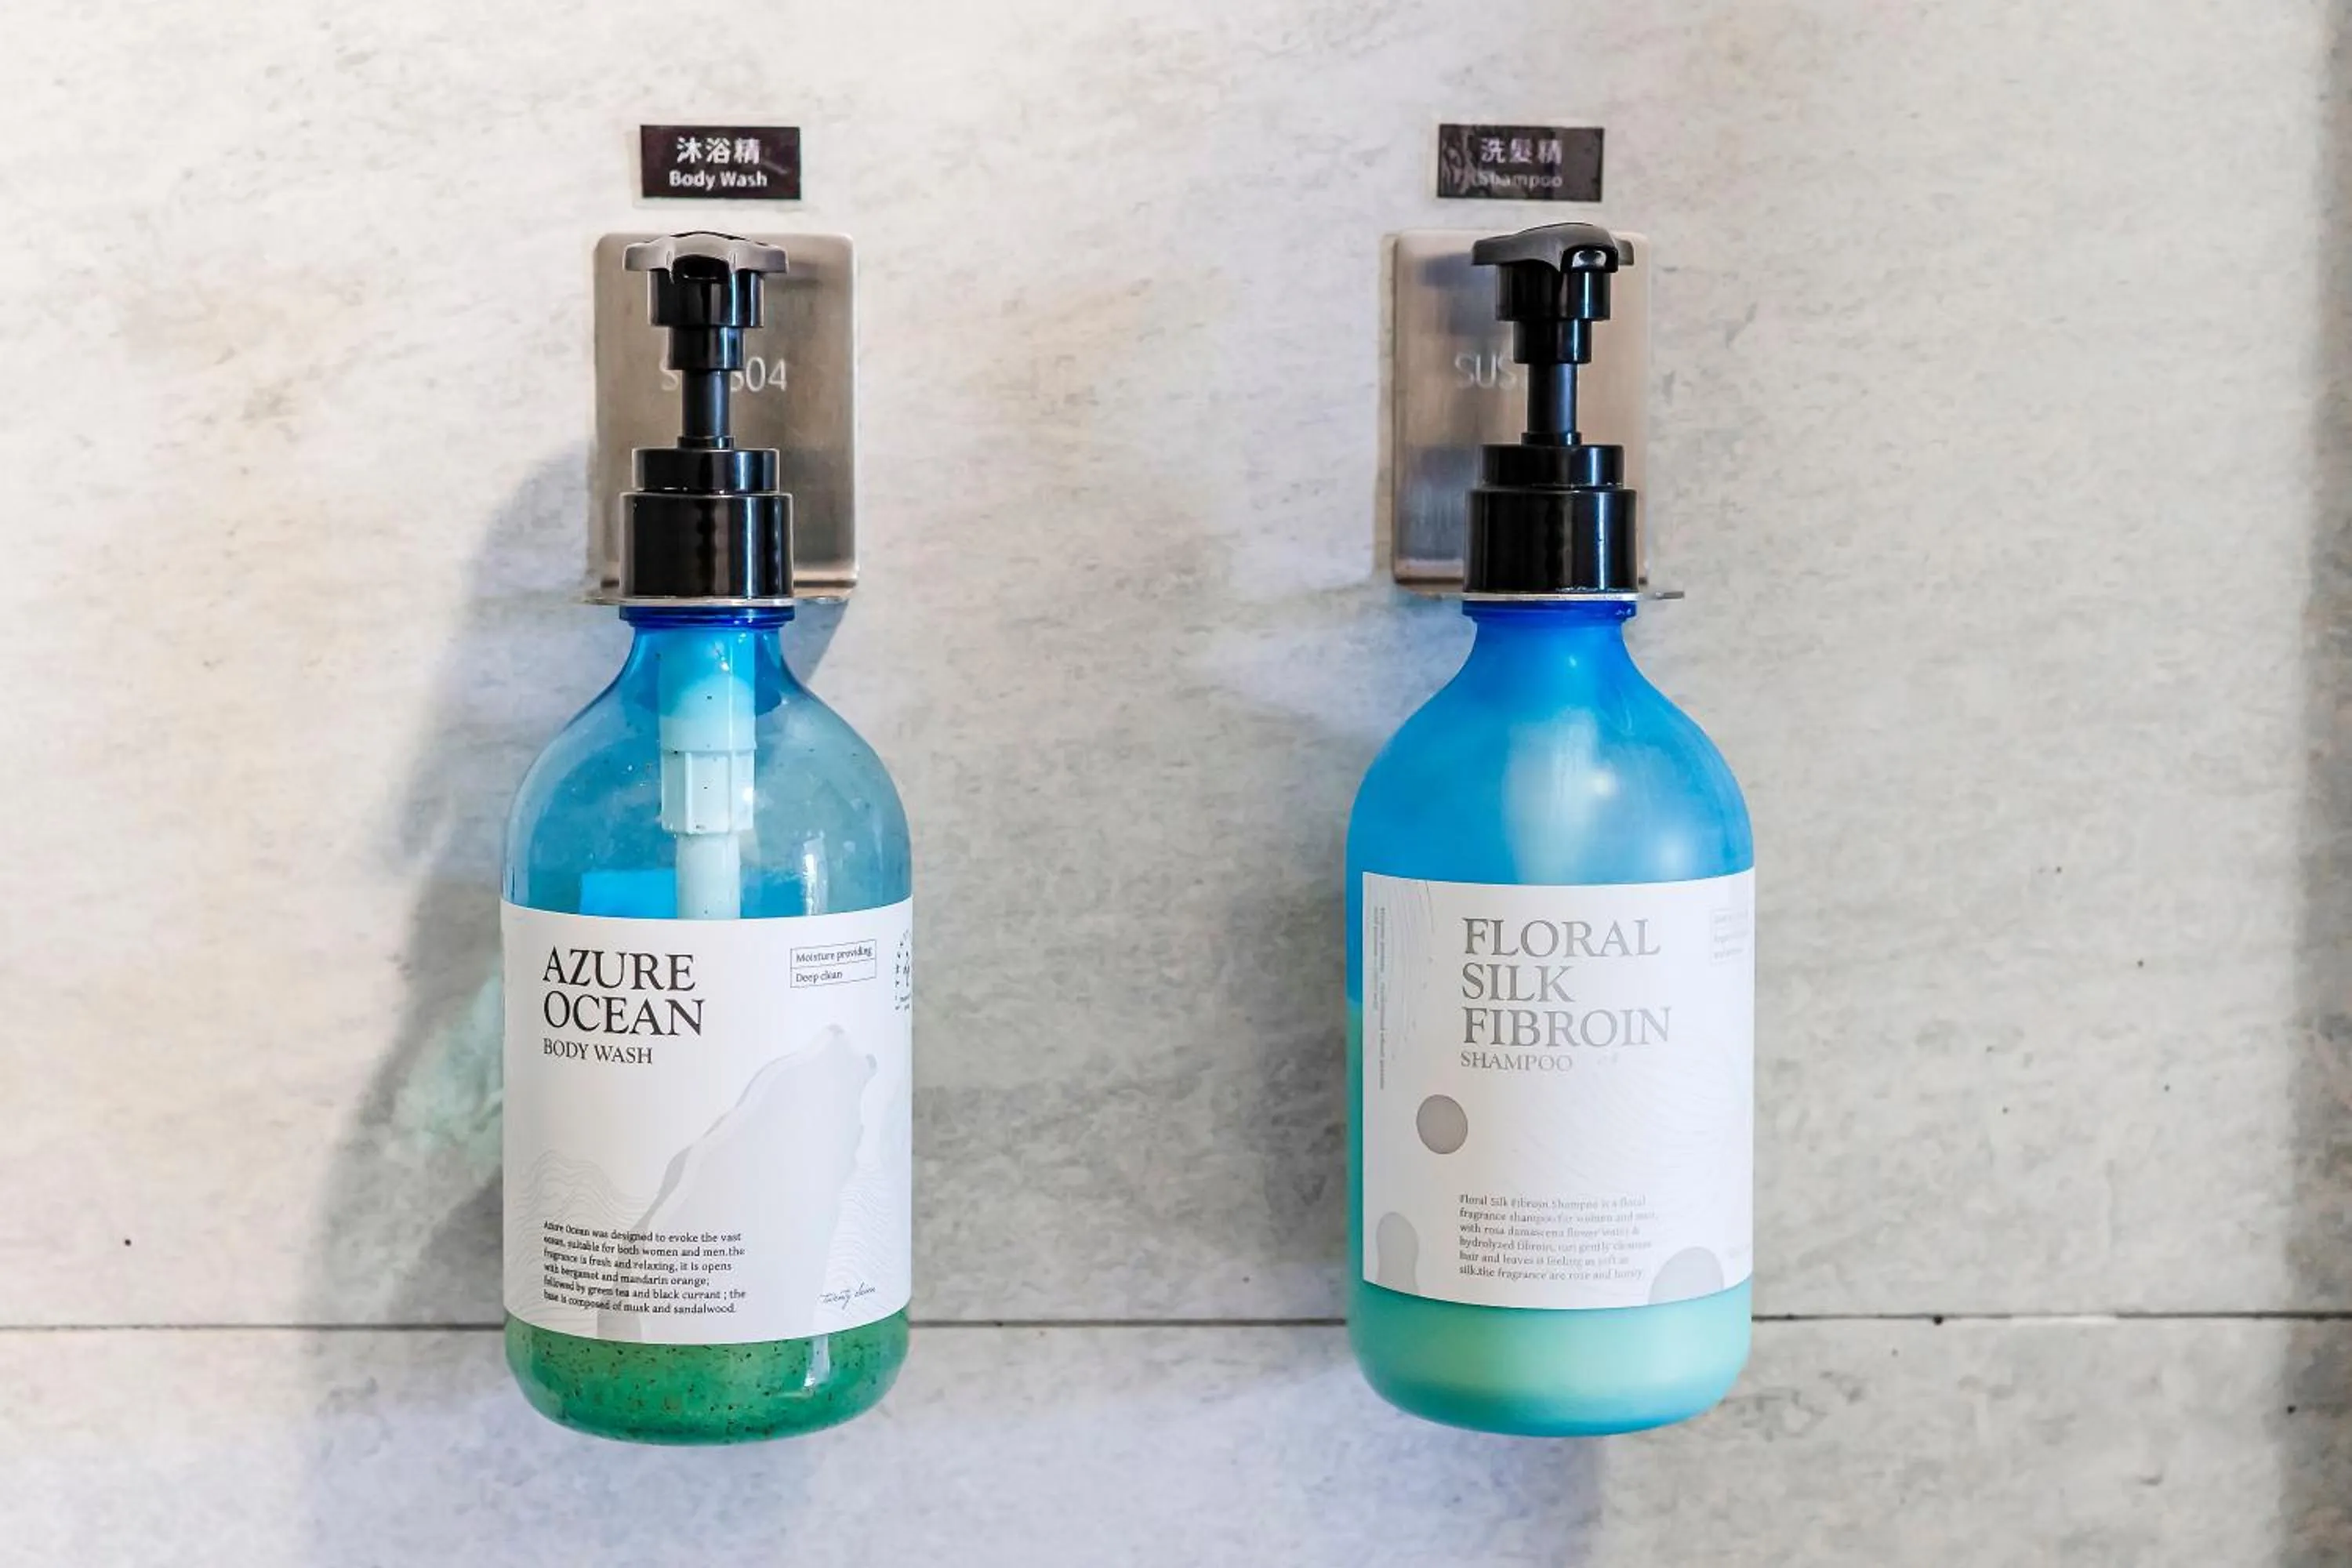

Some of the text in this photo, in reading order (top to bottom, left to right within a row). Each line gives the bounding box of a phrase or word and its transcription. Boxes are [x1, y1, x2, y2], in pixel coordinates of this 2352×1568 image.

[677, 136, 760, 164] 沐浴精
[669, 169, 768, 191] Body Wash
[1478, 171, 1563, 189] Shampoo
[1454, 352, 1526, 390] SUS
[1462, 917, 1661, 957] FLORAL
[796, 946, 873, 963] Moisture providing
[542, 945, 696, 992] AZURE
[796, 971, 843, 983] Deep clean
[1462, 962, 1575, 1003] SILK
[544, 990, 704, 1036] OCEAN
[1462, 1006, 1671, 1047] FIBROIN
[543, 1038, 653, 1065] BODY WASH
[1461, 1051, 1573, 1072] SHAMPOO
[1460, 1194, 1487, 1206] Floral
[1490, 1196, 1507, 1207] Silk
[1460, 1207, 1505, 1221] fragrance
[1615, 1210, 1633, 1221] and
[543, 1221, 563, 1232] Azure
[565, 1225, 590, 1236] Ocean
[612, 1229, 653, 1242] designed
[655, 1233, 666, 1242] to
[668, 1232, 699, 1242] evoke
[701, 1232, 717, 1242] the
[720, 1232, 741, 1241] vast
[1460, 1224, 1480, 1232] with
[567, 1240, 599, 1252] suitable
[601, 1243, 615, 1253] for
[618, 1243, 639, 1254] both
[681, 1246, 700, 1256] and
[1460, 1236, 1515, 1250] hydrolyzed
[543, 1247, 731, 1273] fragrance is fresh and relaxing, it is opens
[1460, 1250, 1479, 1261] hair
[1482, 1253, 1499, 1262] and
[1504, 1254, 1534, 1264] leaves
[543, 1264, 559, 1273] with
[561, 1265, 598, 1280] bergamot
[602, 1272, 618, 1282] and
[620, 1275, 668, 1284] mandarin
[1498, 1268, 1546, 1282] fragrance
[1593, 1269, 1611, 1279] and
[543, 1275, 574, 1290] followed
[575, 1282, 585, 1294] by
[588, 1287, 613, 1296] green
[615, 1288, 630, 1298] tea
[633, 1289, 650, 1298] and
[652, 1289, 679, 1299] black
[729, 1290, 746, 1299] the
[561, 1294, 566, 1303] is
[568, 1297, 610, 1310] composed
[612, 1301, 622, 1311] of
[623, 1302, 650, 1312] musk
[652, 1303, 670, 1312] and
